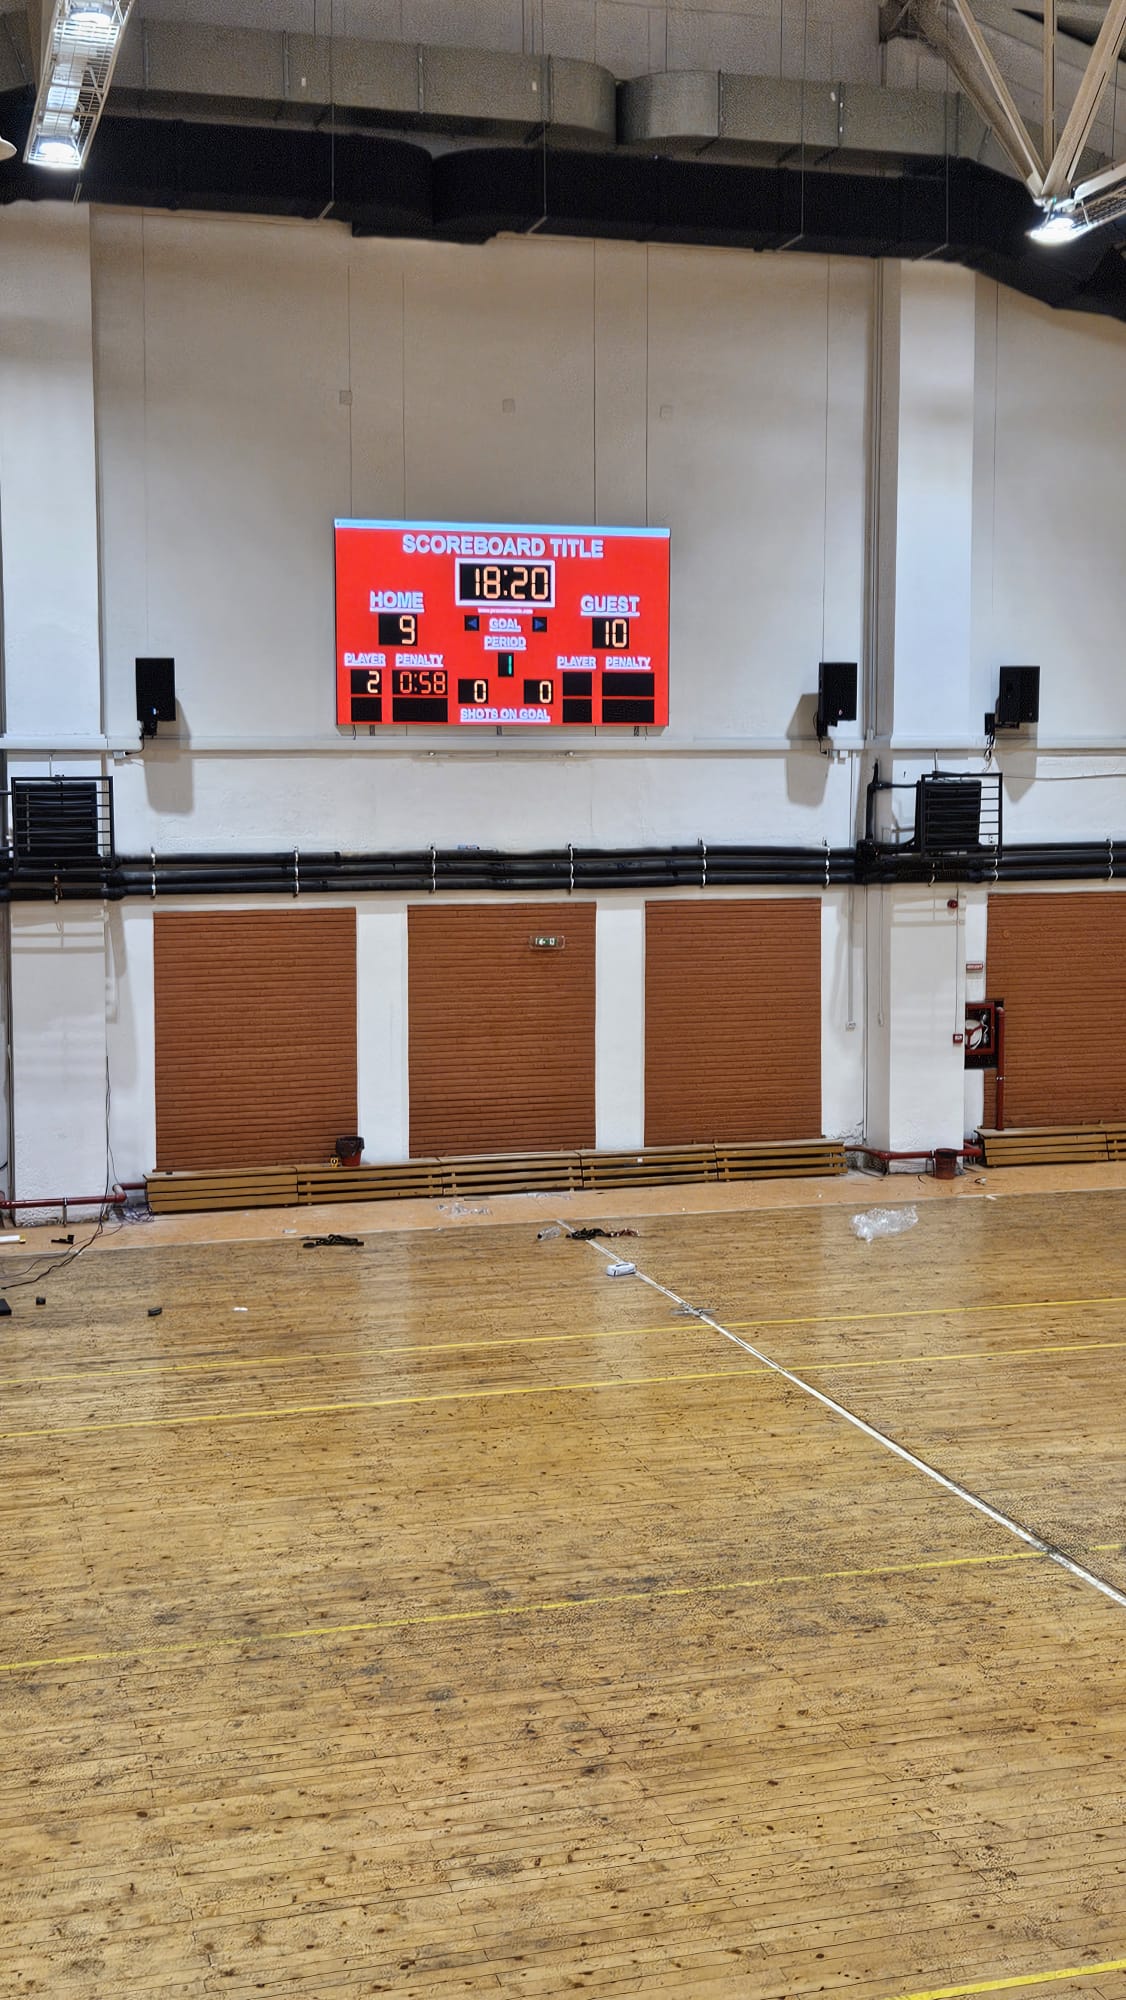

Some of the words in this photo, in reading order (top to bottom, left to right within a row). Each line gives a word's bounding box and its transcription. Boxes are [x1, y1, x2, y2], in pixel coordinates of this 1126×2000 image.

[403, 535, 545, 556] SCOREBOARD
[550, 539, 603, 558] TITLE
[474, 566, 549, 599] 18:20
[370, 591, 424, 610] HOME
[581, 595, 640, 613] GUEST
[400, 616, 416, 645] 9
[489, 618, 521, 630] GOAL
[604, 619, 627, 648] 10
[484, 636, 526, 648] PERIOD
[344, 653, 386, 665] PLAYER
[396, 654, 443, 666] PENALTY
[557, 656, 596, 668] PLAYER
[606, 657, 650, 668] PENALTY
[367, 671, 380, 693] 2
[400, 672, 445, 694] 0:58
[474, 680, 486, 703] 0
[539, 681, 551, 703] 0
[461, 709, 498, 720] SHOTS
[501, 710, 516, 720] ON
[519, 710, 550, 721] GOAL
